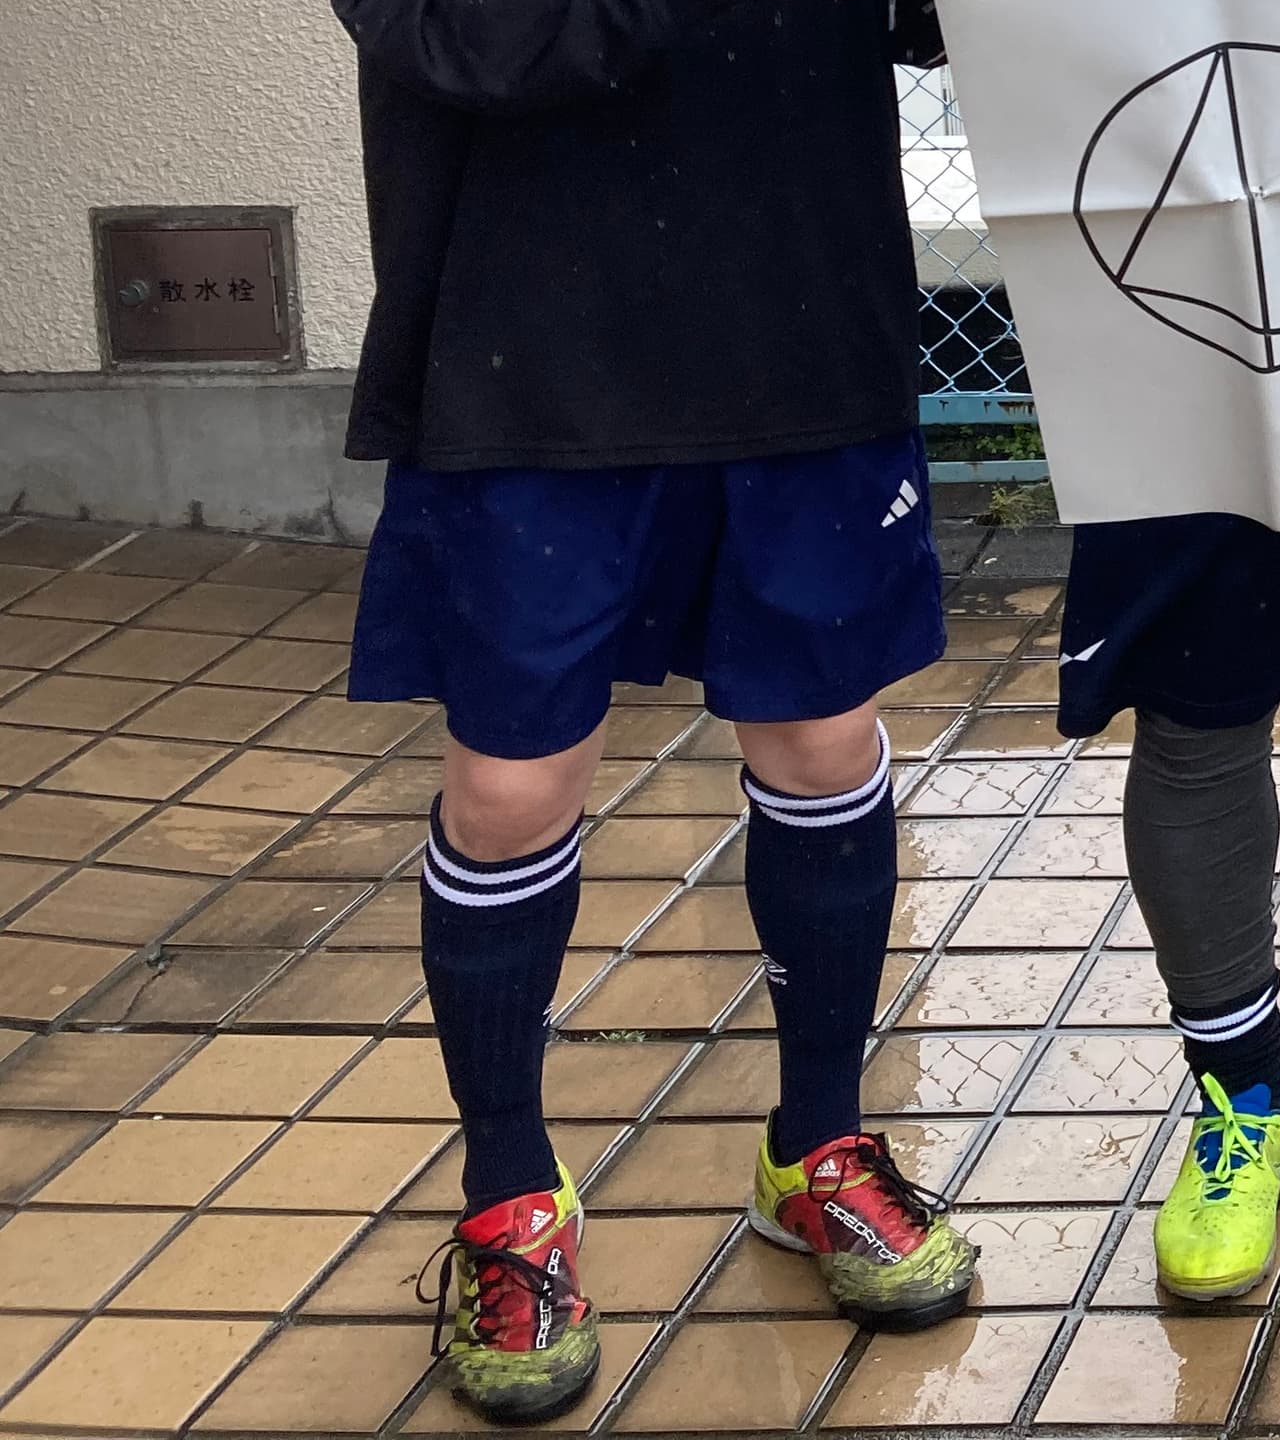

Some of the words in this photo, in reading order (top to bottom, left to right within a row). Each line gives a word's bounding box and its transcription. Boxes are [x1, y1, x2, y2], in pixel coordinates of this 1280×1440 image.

[158, 277, 256, 303] 散水栓
[824, 1201, 902, 1264] PREDATOR
